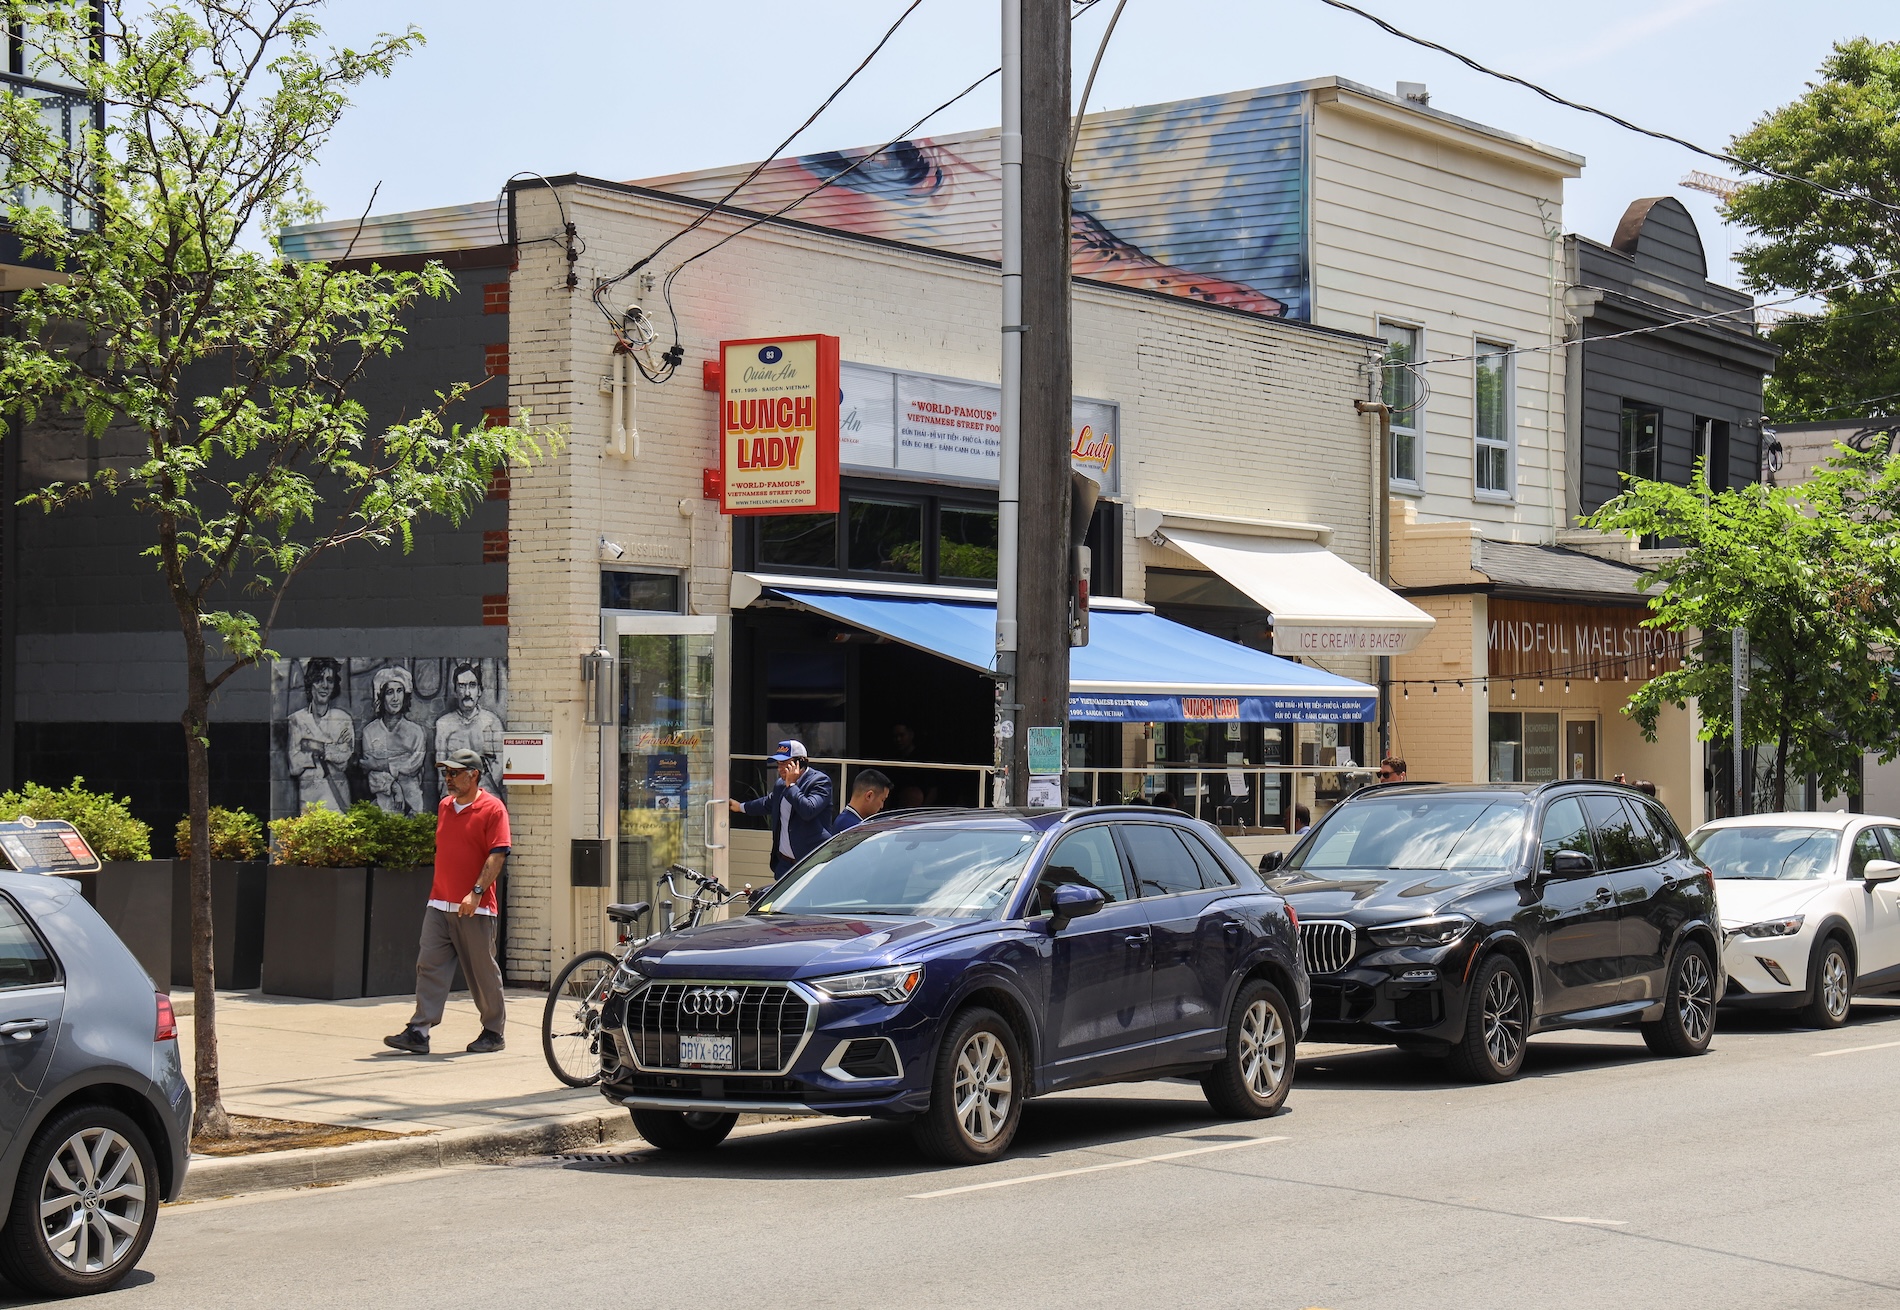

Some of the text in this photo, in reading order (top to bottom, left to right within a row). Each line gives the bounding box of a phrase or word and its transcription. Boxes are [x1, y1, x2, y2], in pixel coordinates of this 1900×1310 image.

[766, 351, 775, 360] 93
[727, 396, 815, 434] LUNCH
[907, 413, 955, 427] VIETNAMESE
[956, 420, 984, 431] STREET
[737, 436, 804, 472] LADY
[1071, 424, 1114, 472] Lady
[631, 542, 680, 559] OSSINGTON
[1300, 633, 1407, 648] ICE CREAM & BAKERY
[1487, 620, 1681, 659] MINDFUL MAELSTROM
[1080, 697, 1114, 706] VIETNAMESE
[1135, 699, 1149, 707] FOOD
[1181, 697, 1240, 720] LUNCH LADY
[1527, 767, 1553, 777] REGISTERED
[712, 1043, 732, 1062] 822
